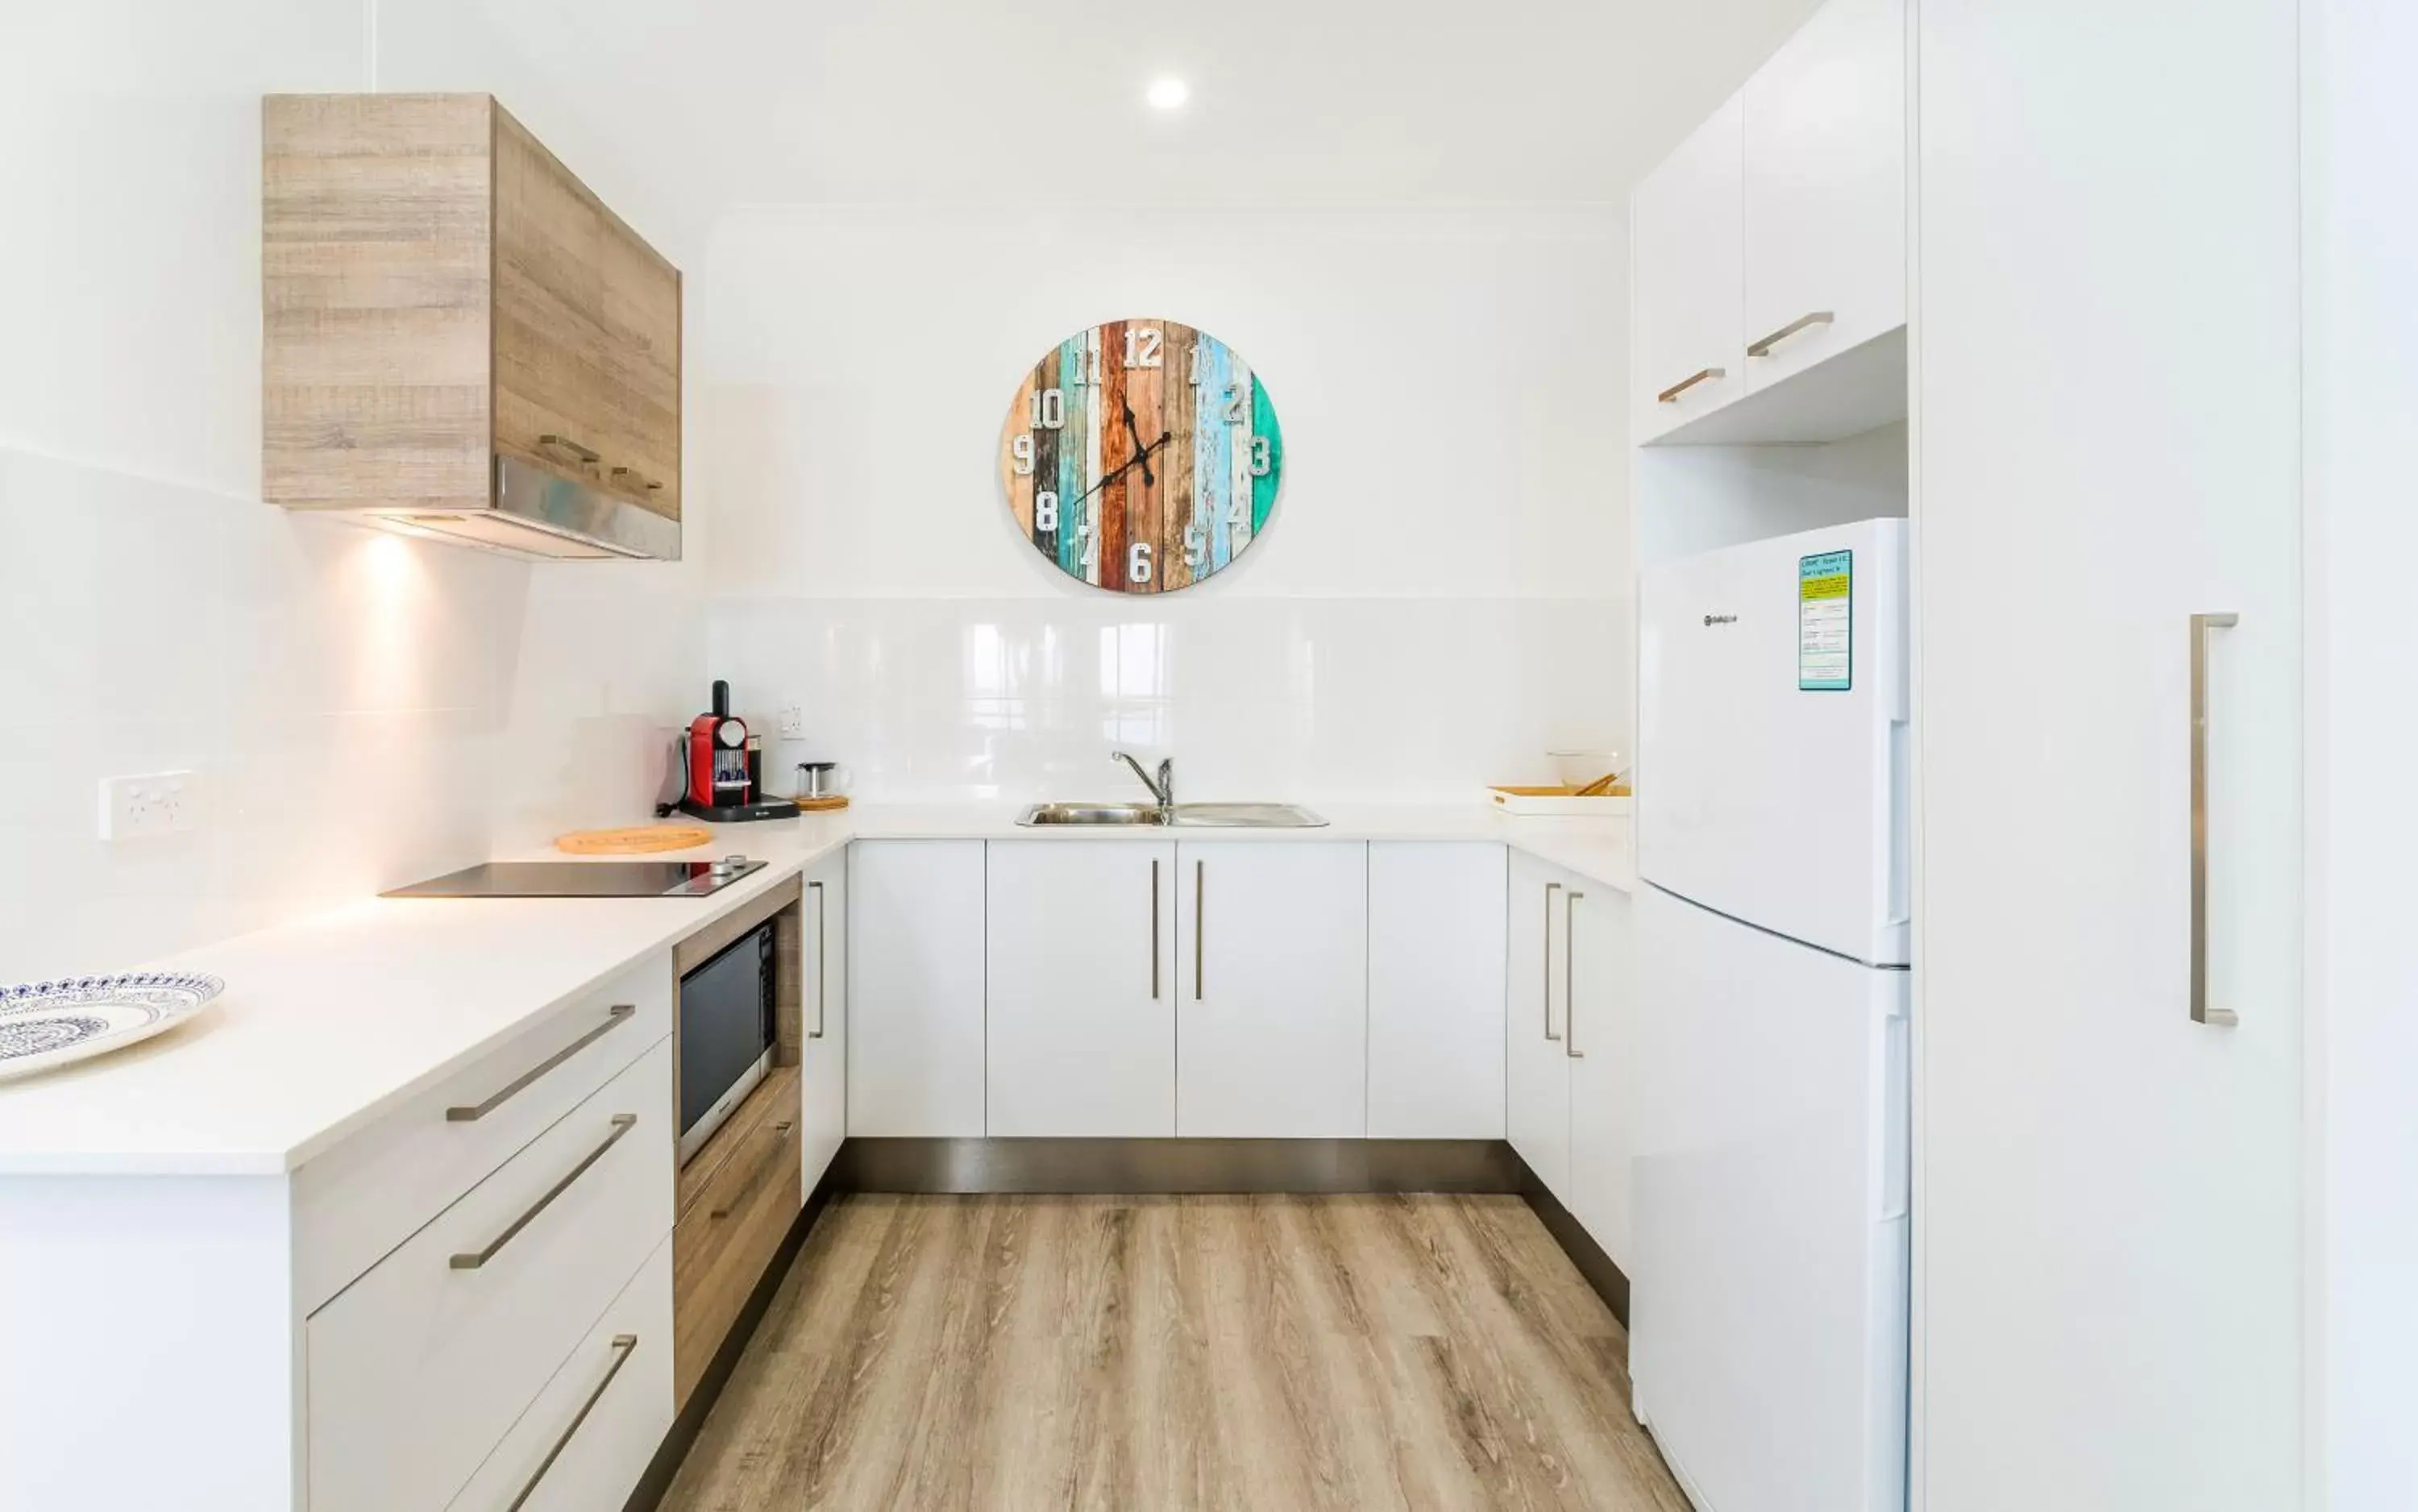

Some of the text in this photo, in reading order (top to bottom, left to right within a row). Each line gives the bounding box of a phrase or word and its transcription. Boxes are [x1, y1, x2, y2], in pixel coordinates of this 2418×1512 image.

[1074, 347, 1101, 386] 11
[1124, 329, 1162, 368] 12
[1190, 346, 1200, 385] 1
[1029, 388, 1064, 430] 10
[1223, 382, 1245, 423] 2
[1013, 434, 1034, 475] 9
[1249, 436, 1270, 476] 3
[1036, 492, 1058, 531] 8
[1229, 494, 1250, 533] 4
[1078, 525, 1098, 565] 7
[1129, 542, 1152, 583] 6
[1184, 525, 1205, 566] 5
